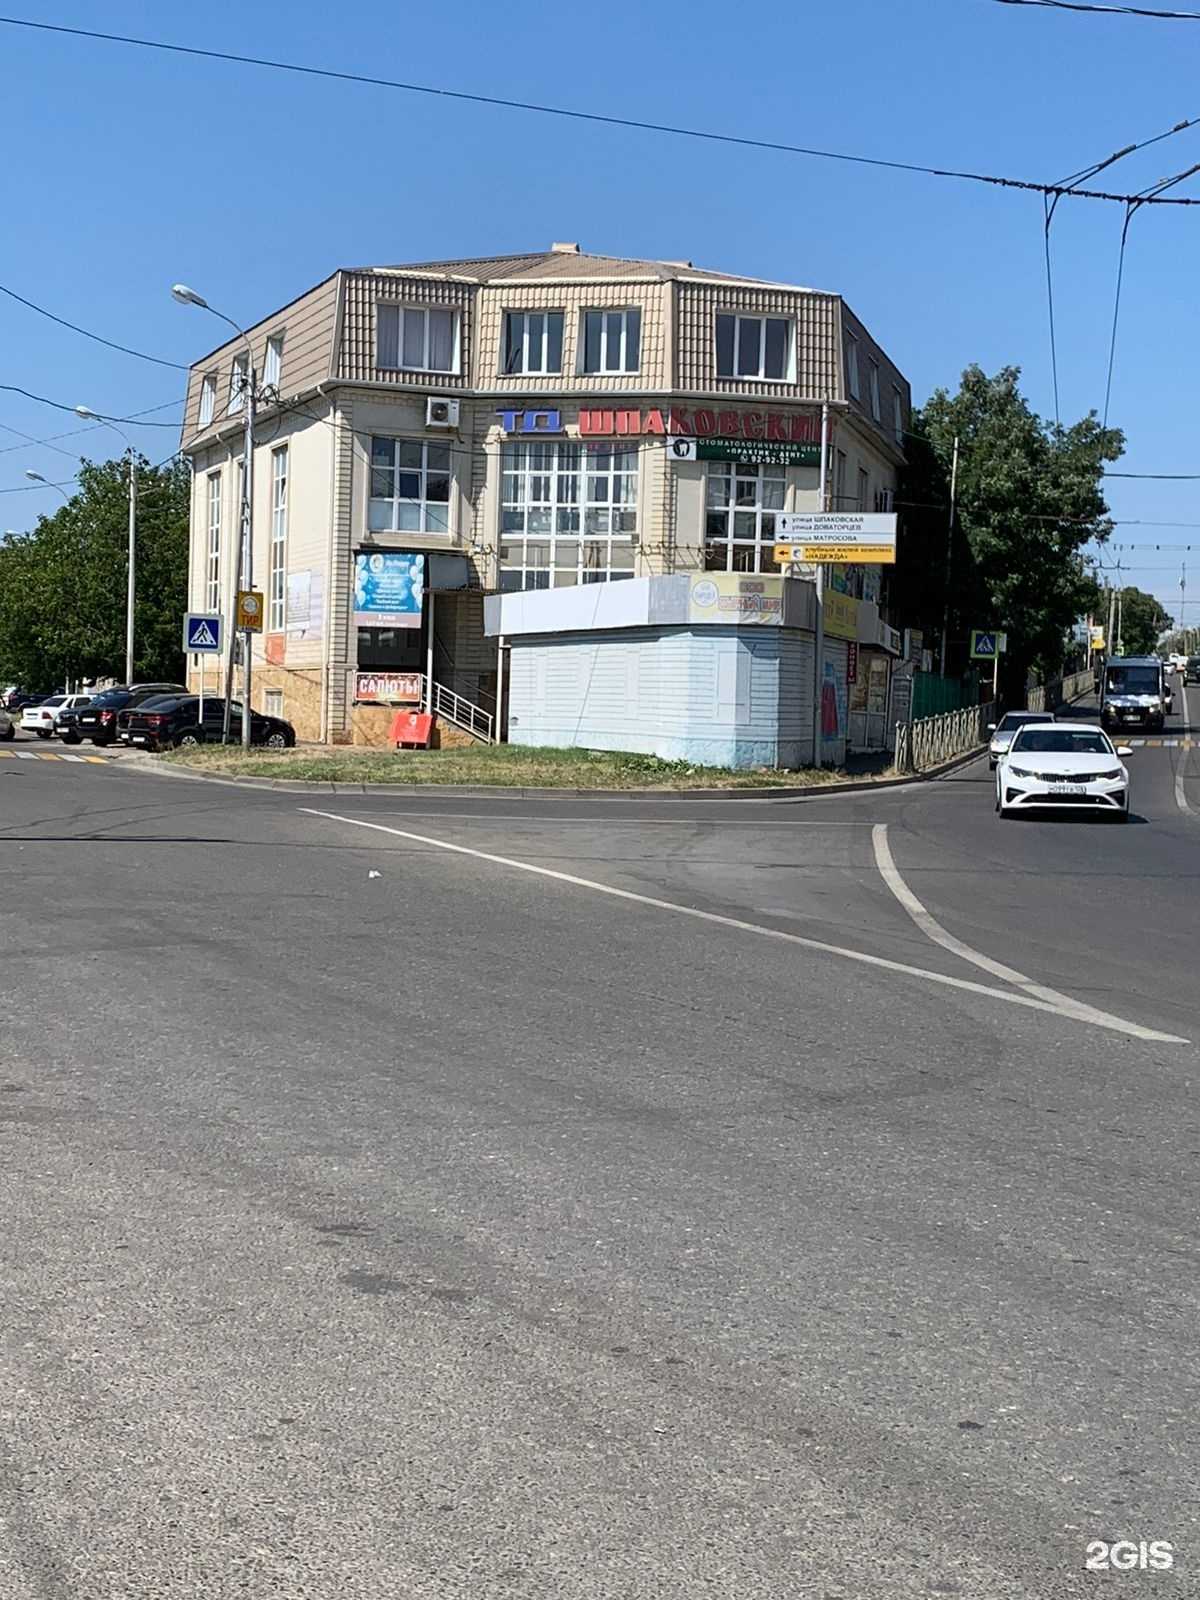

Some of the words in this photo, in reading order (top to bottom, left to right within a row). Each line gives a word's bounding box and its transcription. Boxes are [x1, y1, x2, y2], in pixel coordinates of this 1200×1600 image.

[494, 408, 563, 434] ТД
[699, 439, 798, 450] СТОМАТОЛОГИЧЕСКИЙ
[360, 679, 418, 695] САЛЮТЫ
